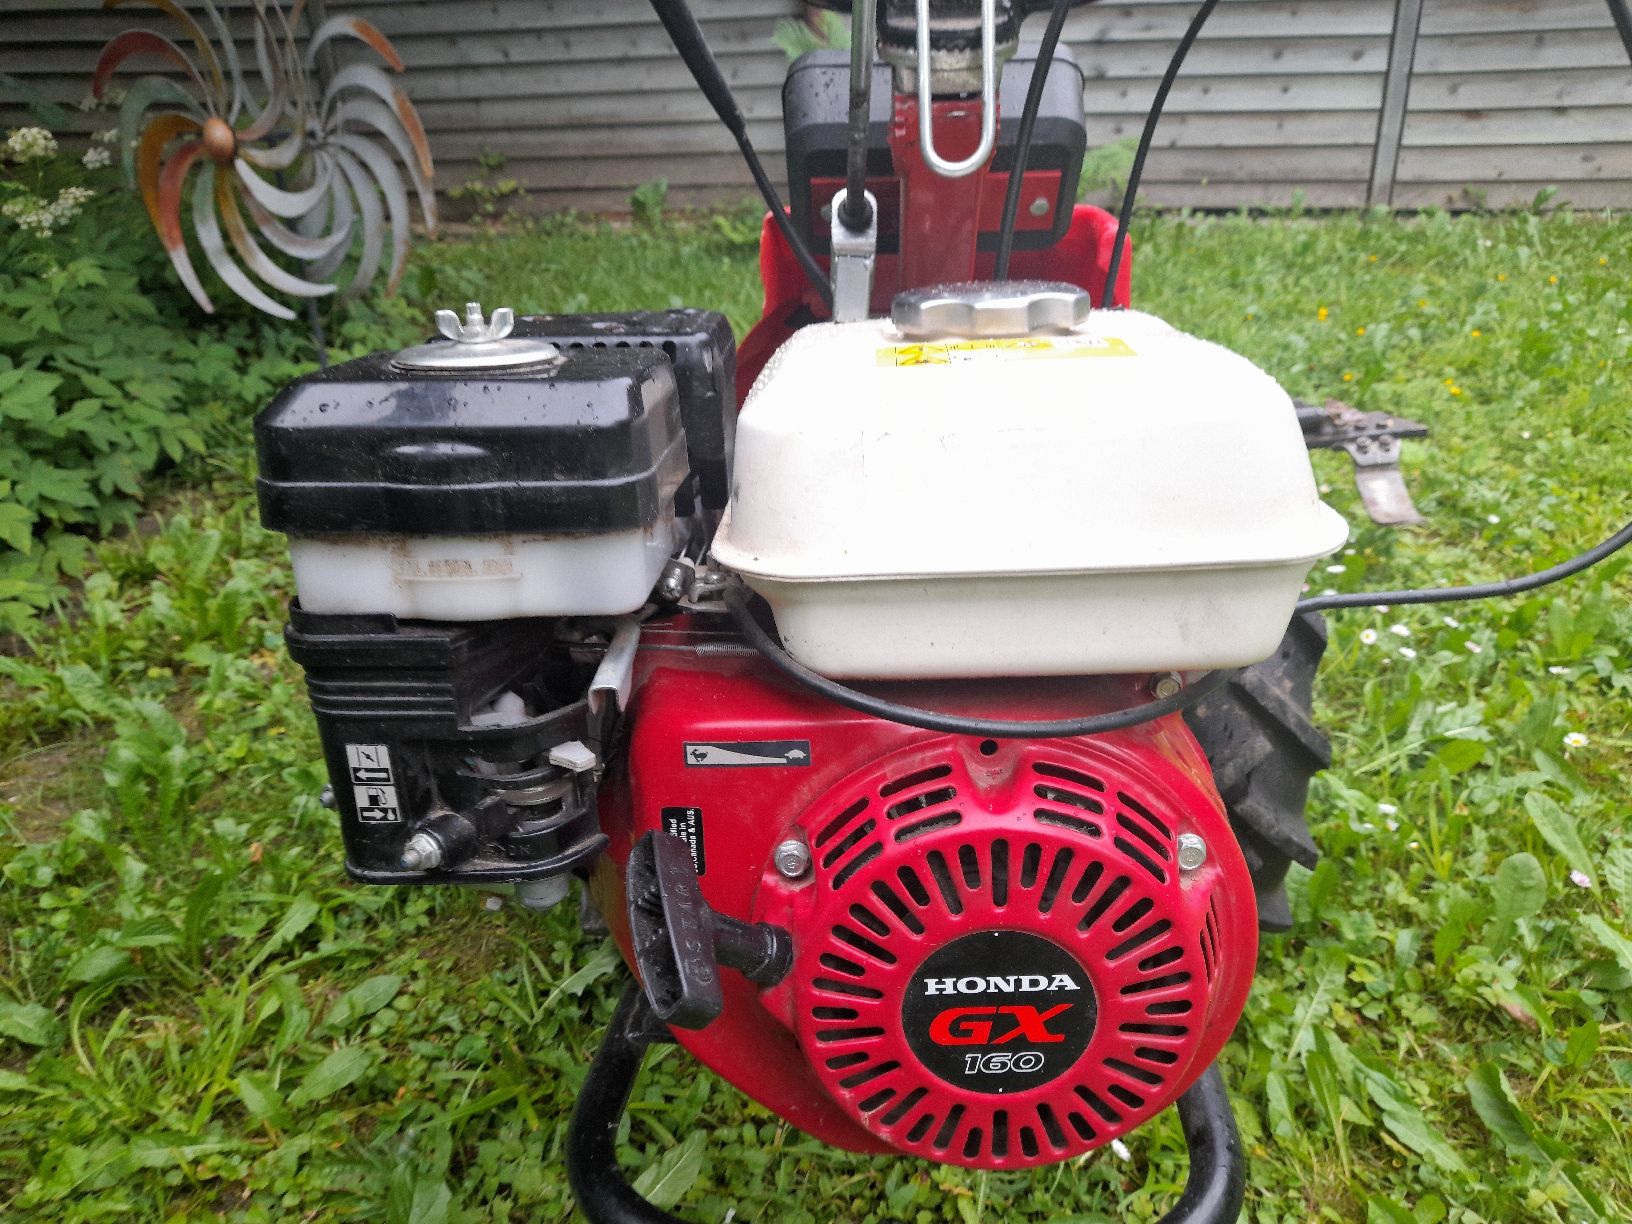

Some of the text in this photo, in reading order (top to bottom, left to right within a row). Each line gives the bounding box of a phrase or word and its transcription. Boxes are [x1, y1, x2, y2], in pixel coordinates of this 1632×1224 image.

[679, 822, 687, 830] in
[924, 974, 1081, 996] HONDA
[929, 1003, 1075, 1046] GX
[965, 1051, 1045, 1074] 160
